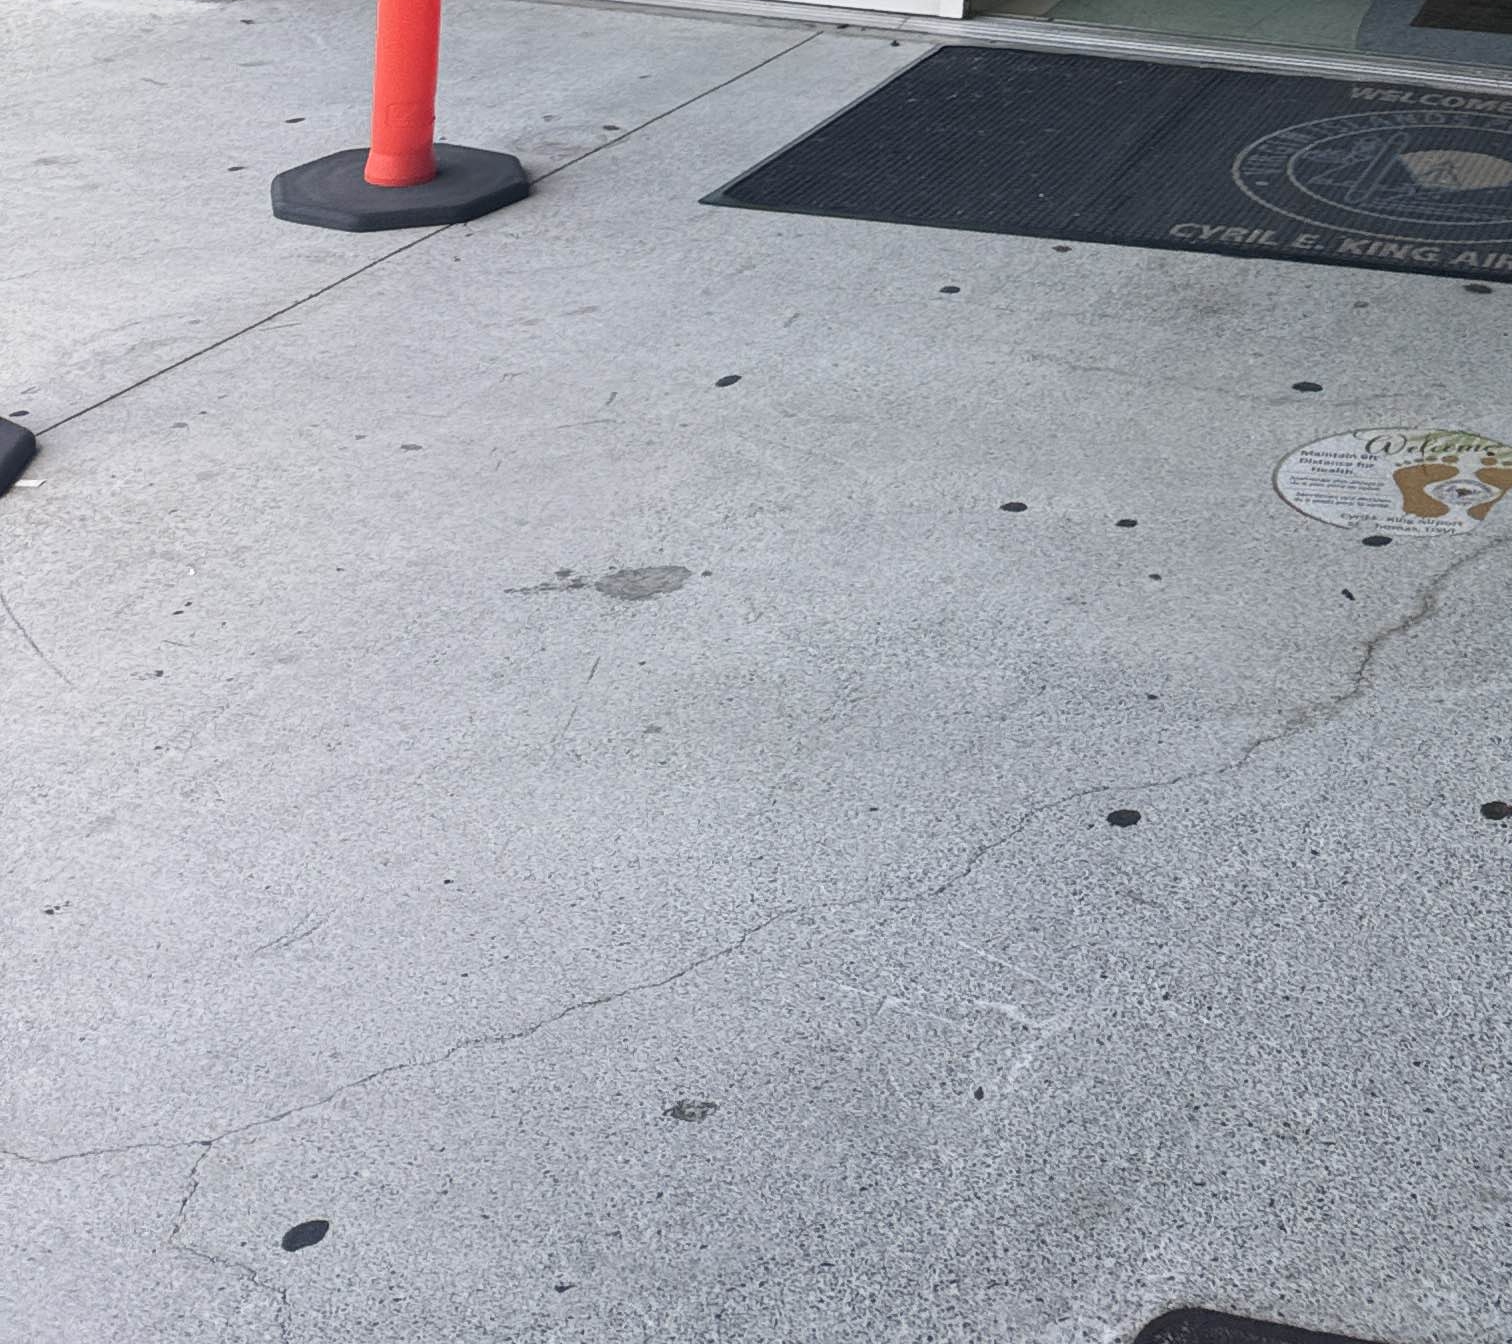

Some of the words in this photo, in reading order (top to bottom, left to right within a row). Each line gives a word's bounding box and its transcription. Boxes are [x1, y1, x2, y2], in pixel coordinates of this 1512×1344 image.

[1168, 220, 1281, 247] CYRIL
[1288, 229, 1326, 251] E.
[1339, 236, 1442, 266] KING
